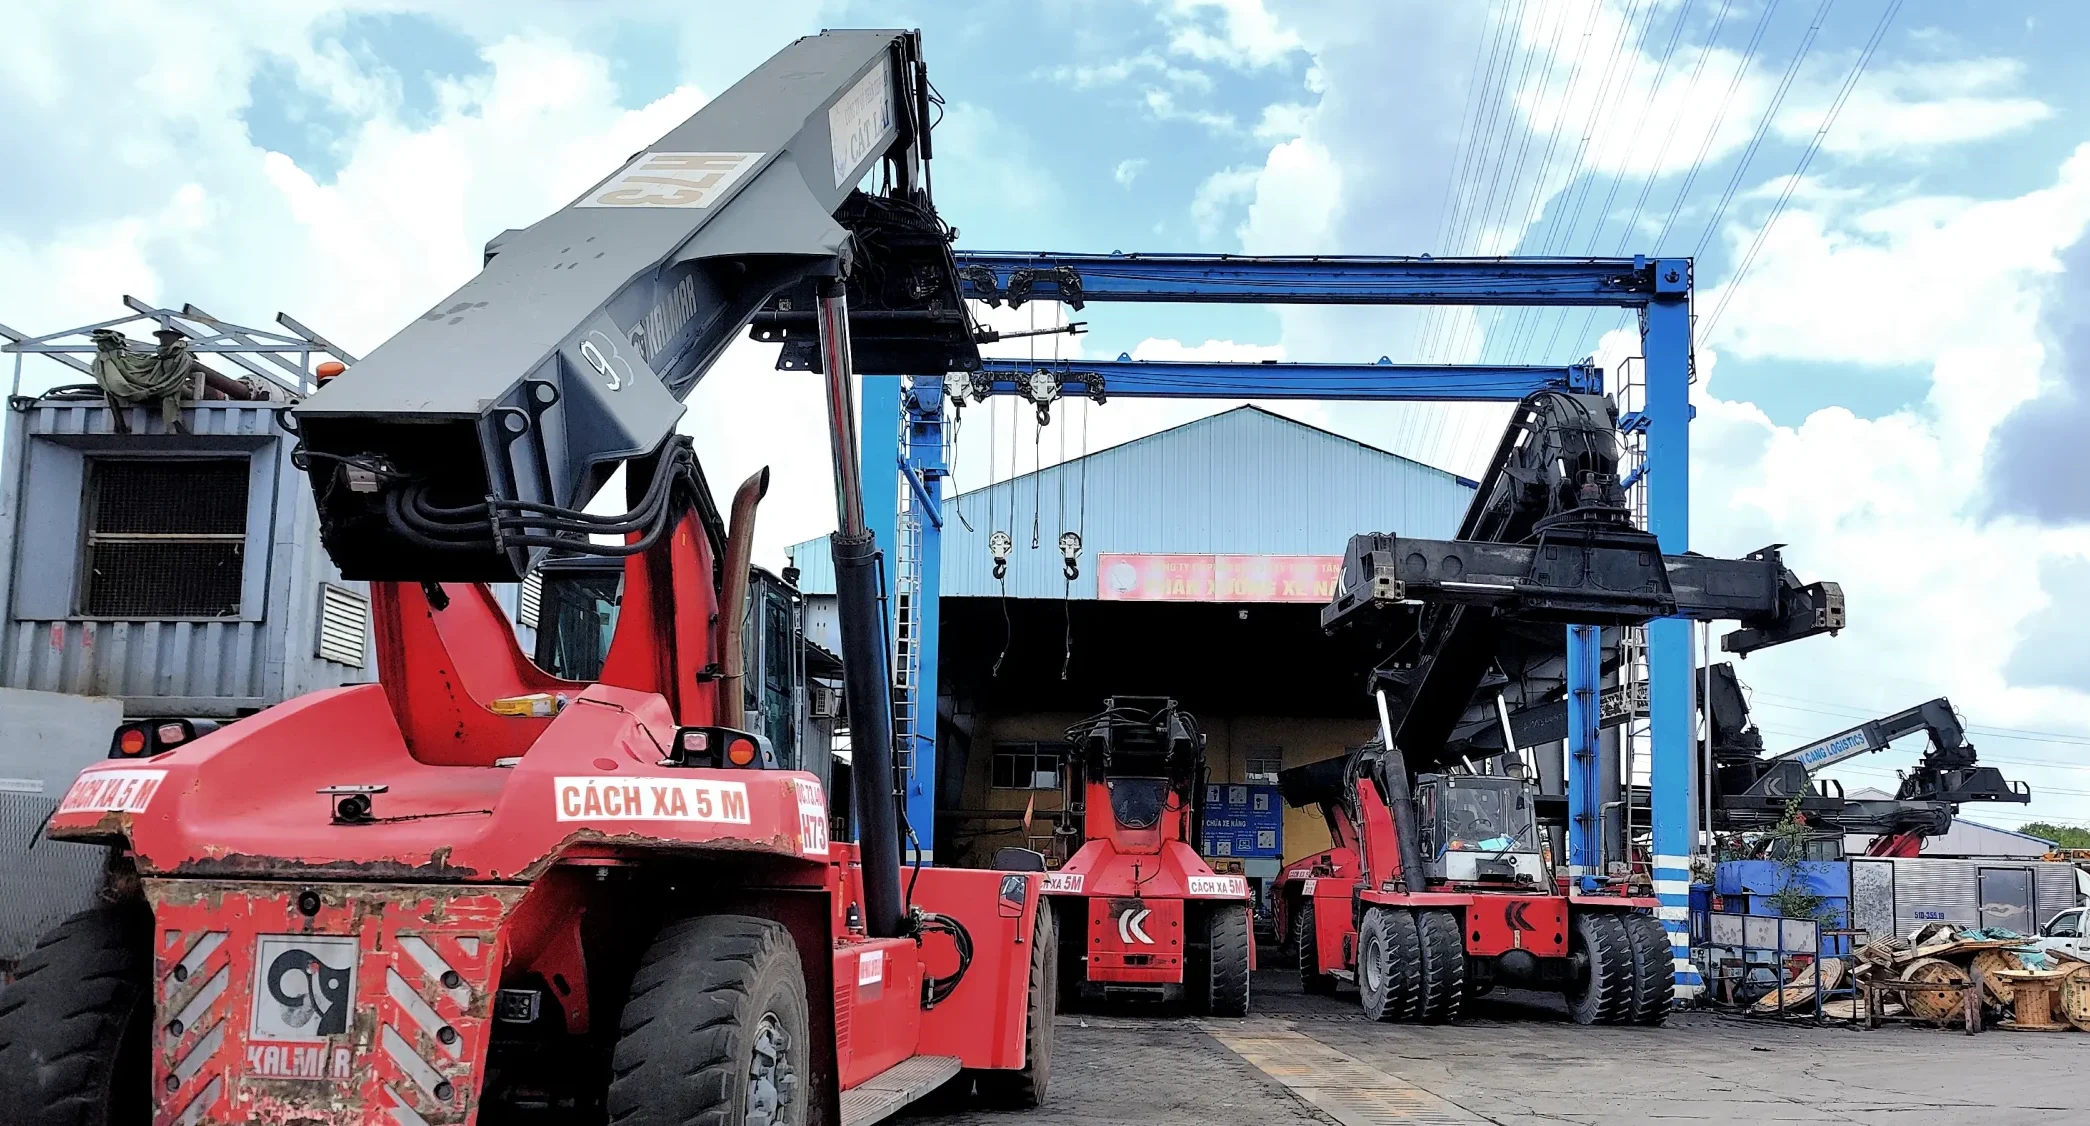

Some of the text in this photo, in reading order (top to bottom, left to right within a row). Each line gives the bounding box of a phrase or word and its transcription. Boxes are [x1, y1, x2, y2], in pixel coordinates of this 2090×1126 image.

[850, 118, 871, 163] CÁT
[873, 97, 890, 139] LÁI
[597, 155, 747, 205] H73
[645, 273, 698, 360] KALMAR
[1805, 747, 1827, 764] CANG
[1826, 733, 1865, 756] LOGISTICS
[117, 778, 138, 808] 5
[562, 779, 746, 820] CÁCH XA 5 M
[802, 813, 826, 850] H73
[1191, 879, 1215, 893] CÁCH
[1216, 882, 1228, 894] XA
[246, 1045, 351, 1078] KALMR
